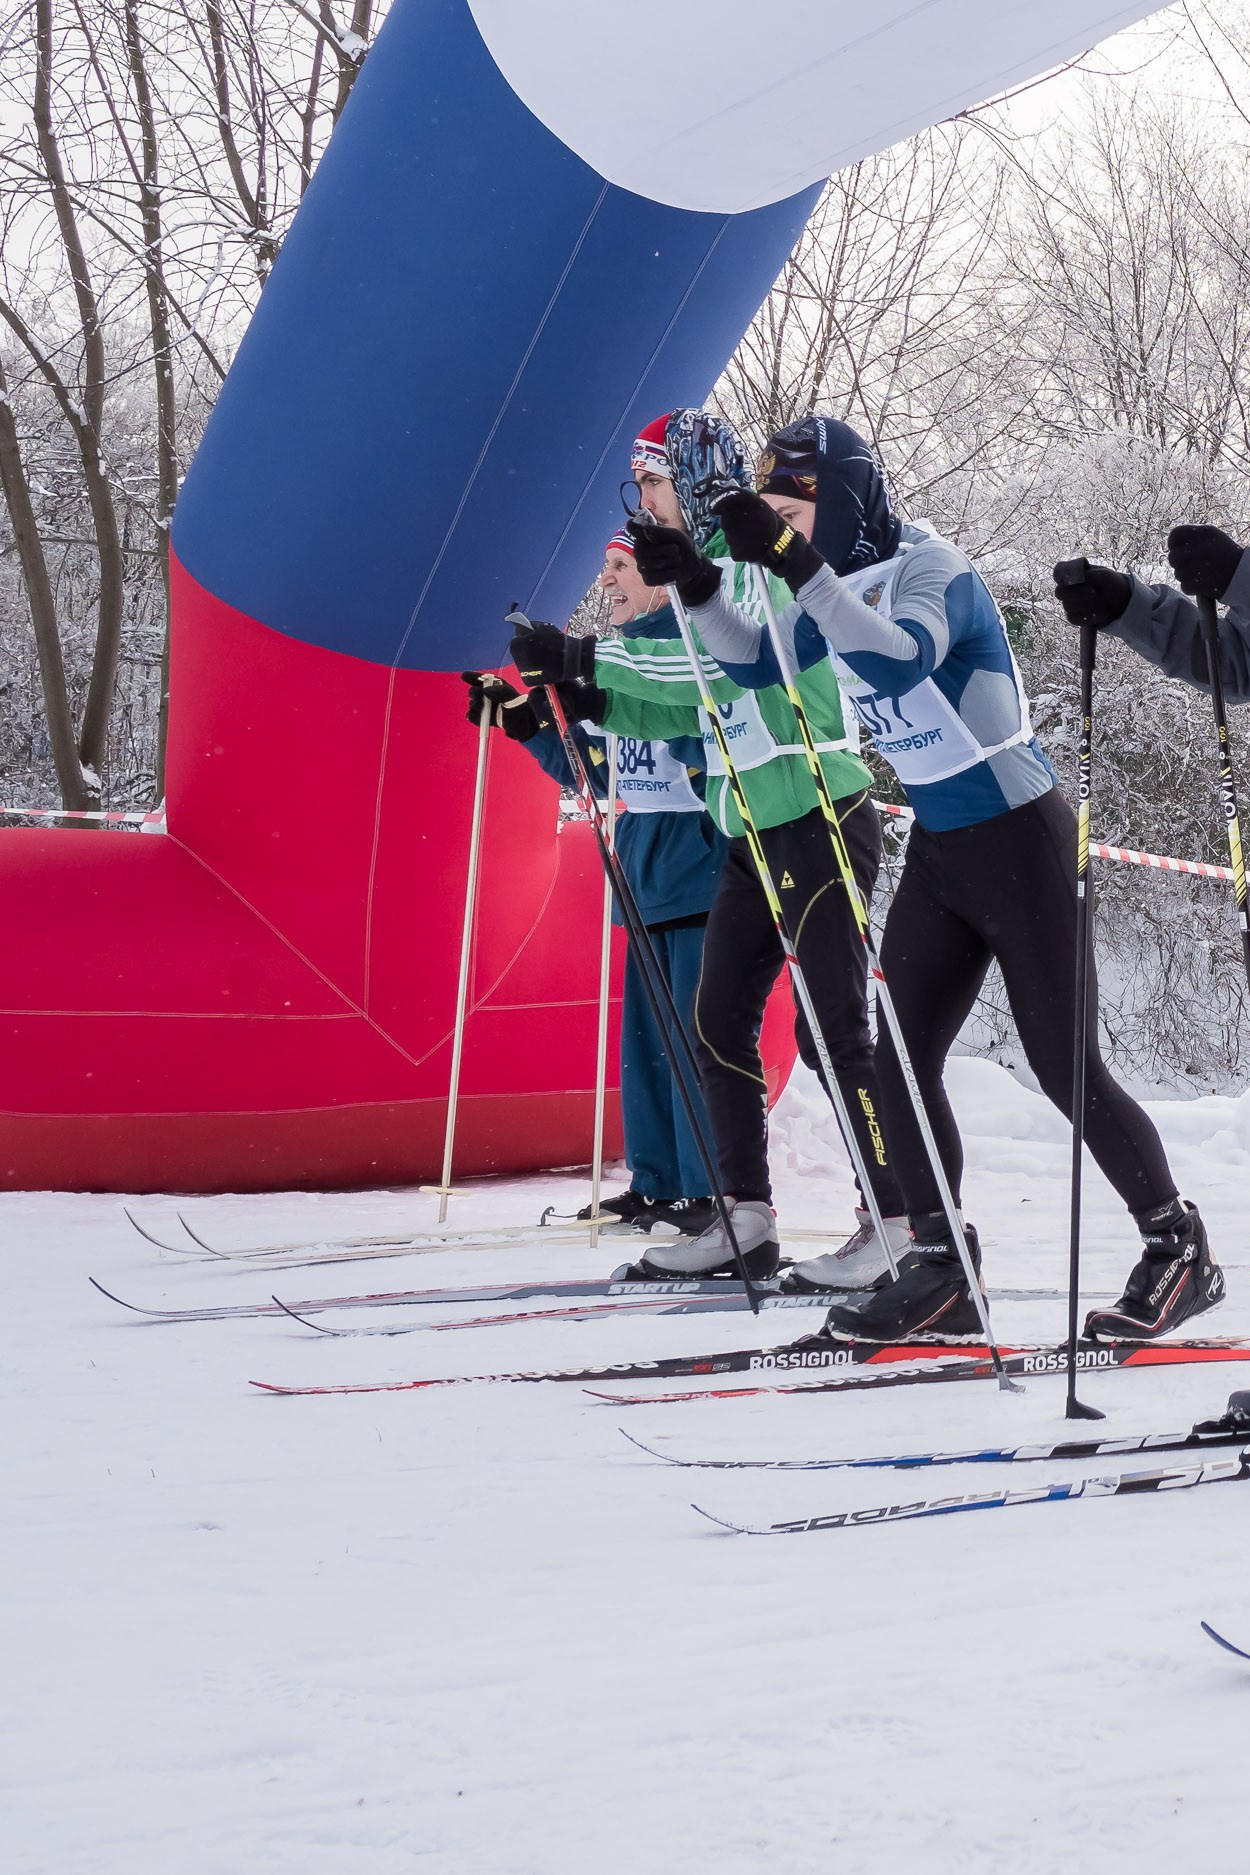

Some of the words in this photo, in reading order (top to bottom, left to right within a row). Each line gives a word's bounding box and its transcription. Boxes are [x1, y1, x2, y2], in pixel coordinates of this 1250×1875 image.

[816, 417, 827, 455] SWIX
[857, 1088, 888, 1166] FISCHER
[608, 1283, 674, 1295] START
[671, 1282, 701, 1293] UP
[763, 1297, 820, 1308] START
[749, 1350, 858, 1369] ROSSIGNOL
[1023, 1350, 1119, 1372] ROSSGNOL
